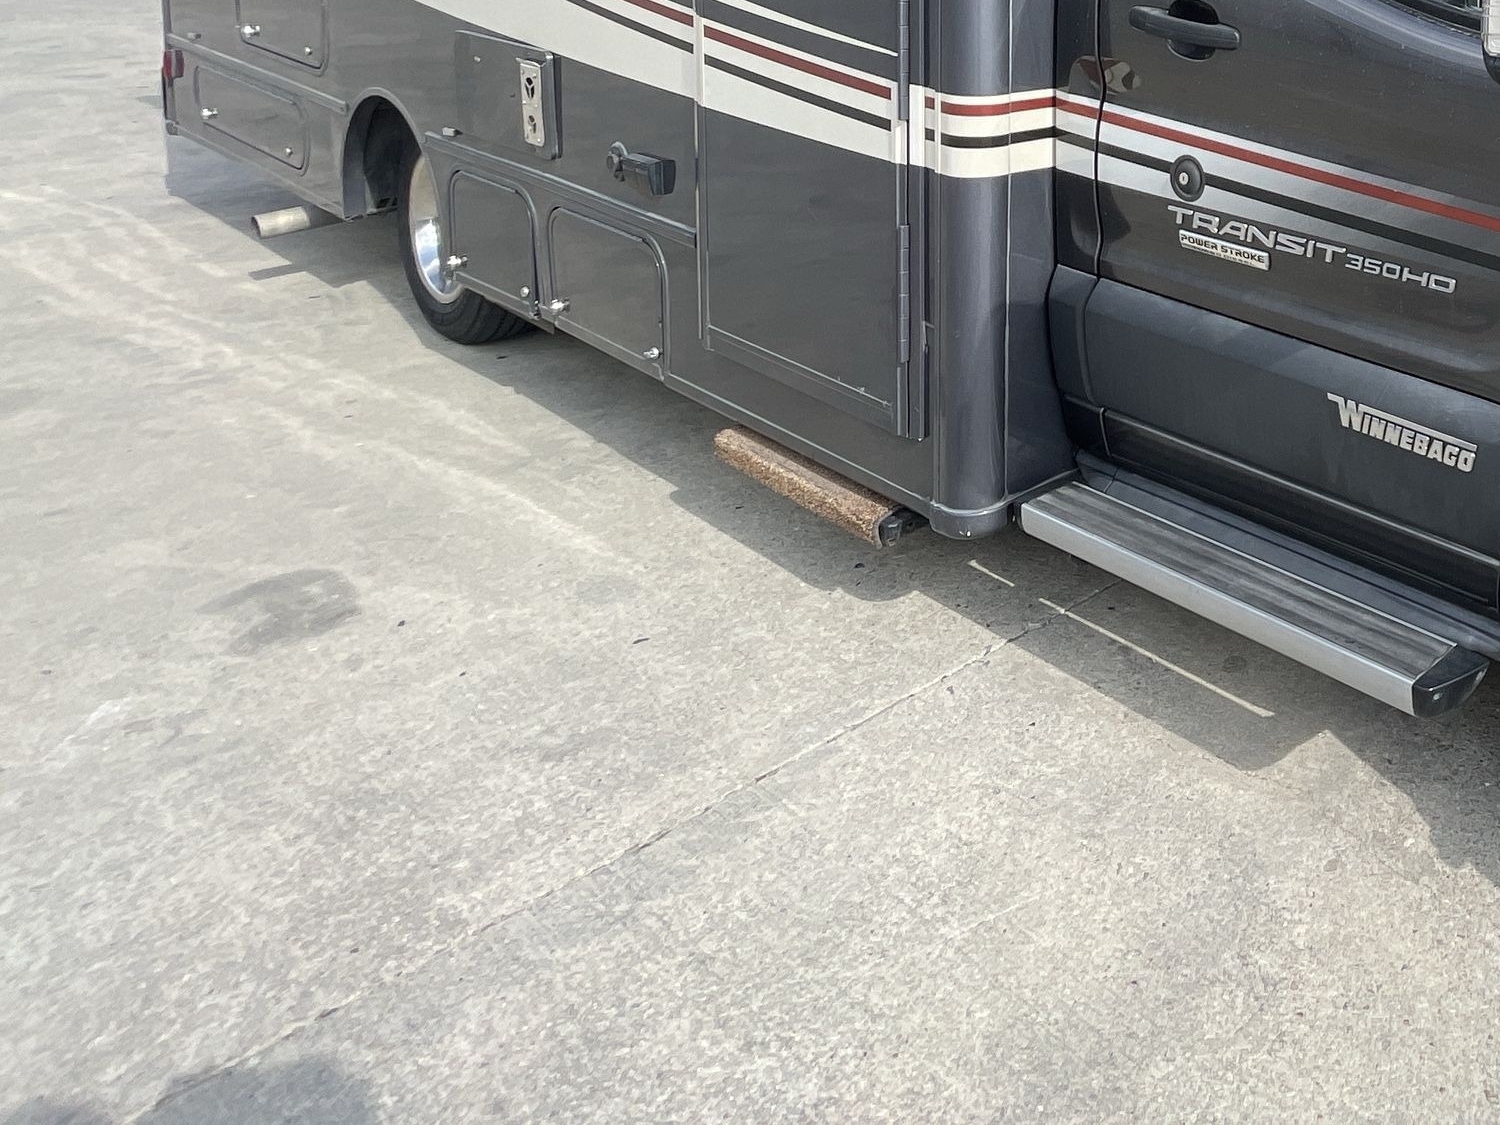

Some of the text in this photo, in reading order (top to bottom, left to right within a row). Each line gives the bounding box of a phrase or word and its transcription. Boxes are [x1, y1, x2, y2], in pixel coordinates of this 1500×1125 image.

[1167, 205, 1457, 293] TRANSIT 350HD
[1180, 233, 1218, 251] POWER
[1220, 244, 1265, 264] STROKE
[1327, 392, 1478, 473] WINNEBAGO
